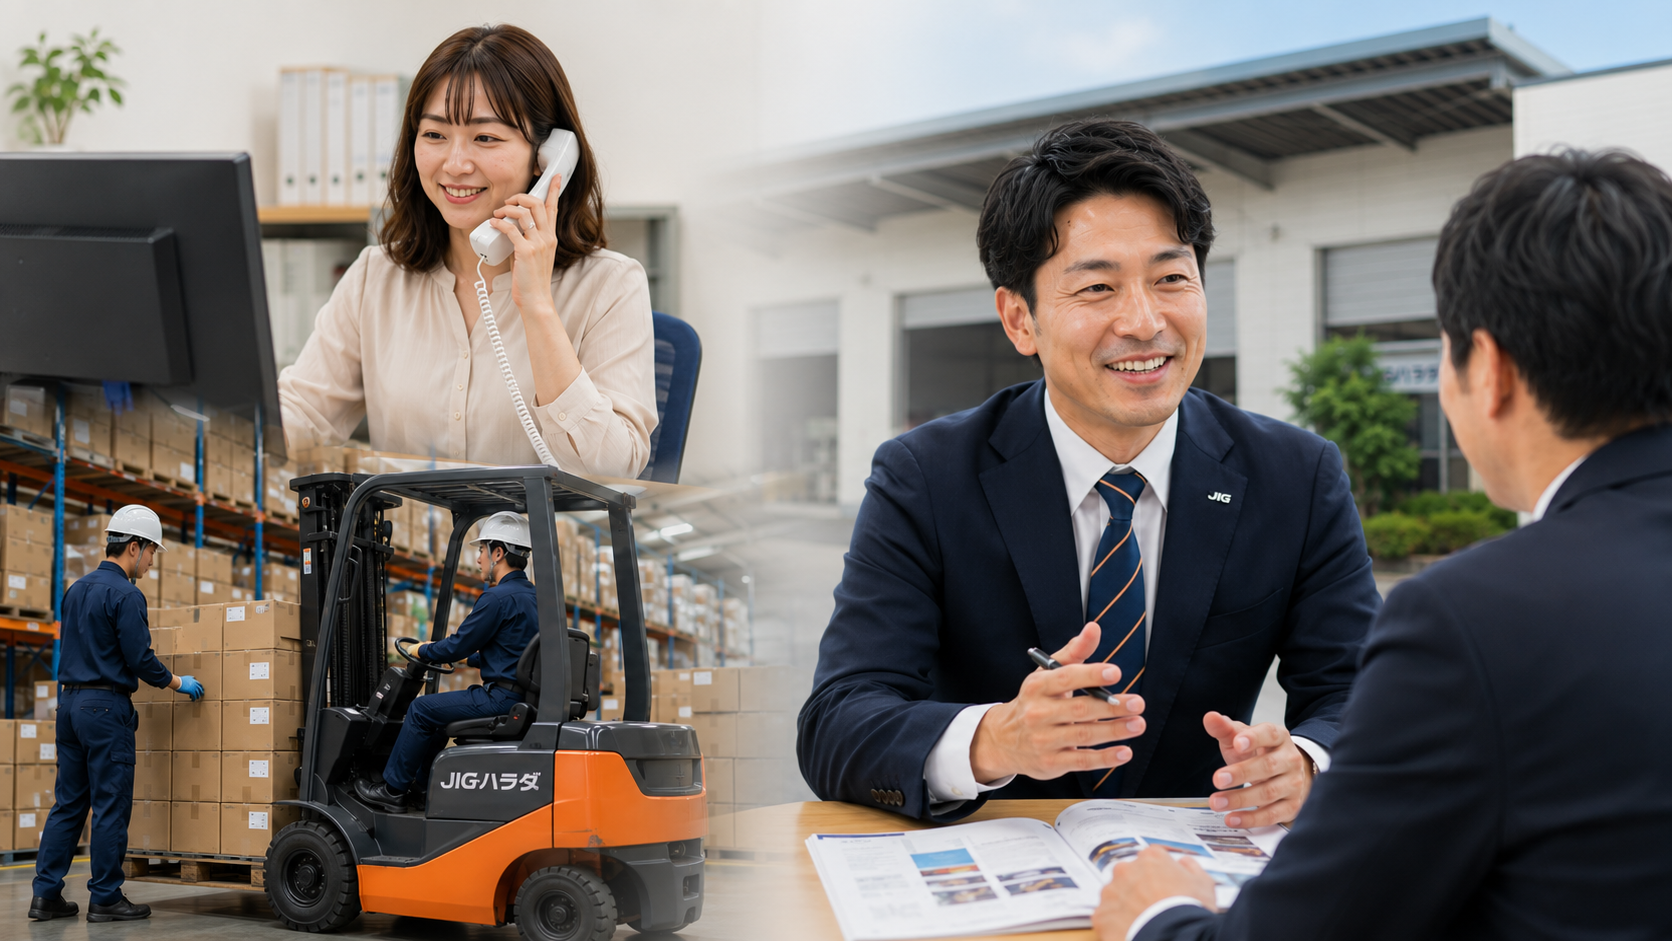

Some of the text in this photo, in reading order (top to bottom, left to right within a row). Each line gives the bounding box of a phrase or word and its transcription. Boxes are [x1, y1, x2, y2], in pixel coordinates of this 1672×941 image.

[1207, 491, 1232, 504] JIG
[440, 771, 541, 792] JIGハラダ
